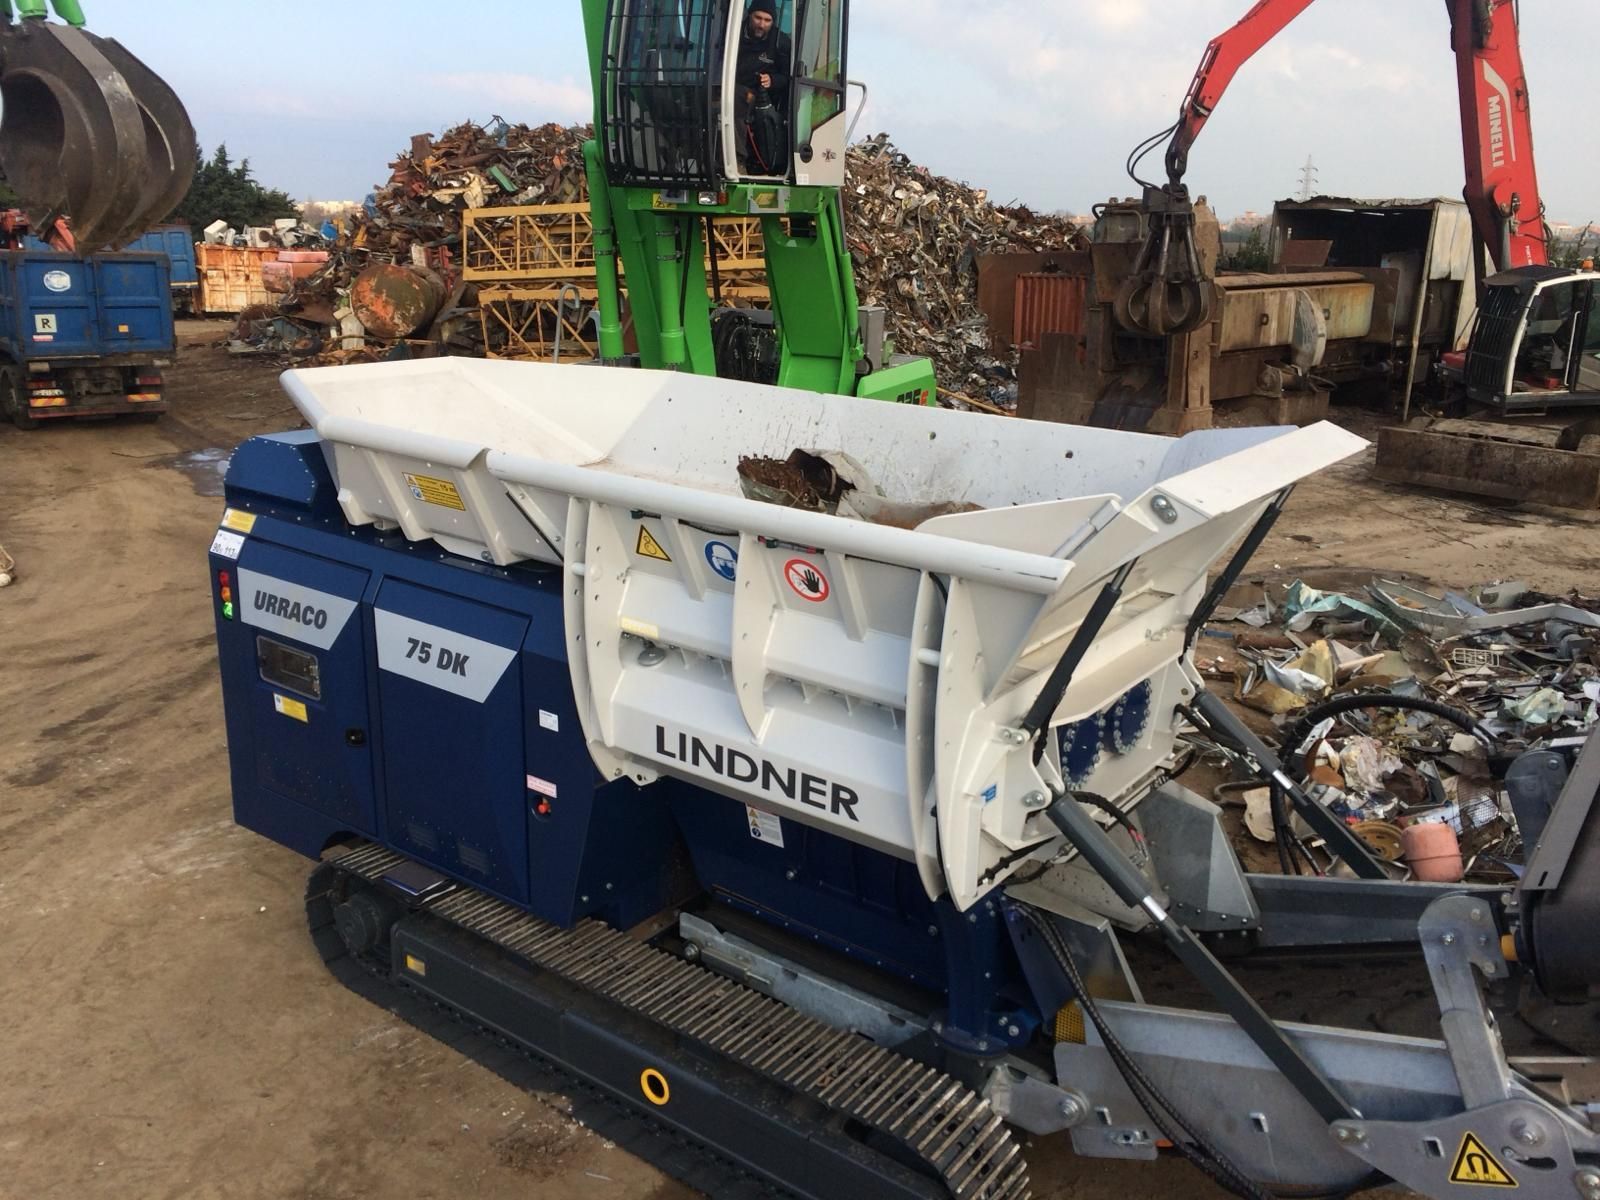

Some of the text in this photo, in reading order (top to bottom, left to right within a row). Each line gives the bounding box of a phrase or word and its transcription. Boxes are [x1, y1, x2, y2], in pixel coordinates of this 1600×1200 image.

[1488, 95, 1504, 168] MINELLI
[41, 318, 52, 329] R
[254, 591, 328, 630] URRACO
[405, 637, 469, 677] 75 DK
[656, 725, 859, 821] LINDNER
